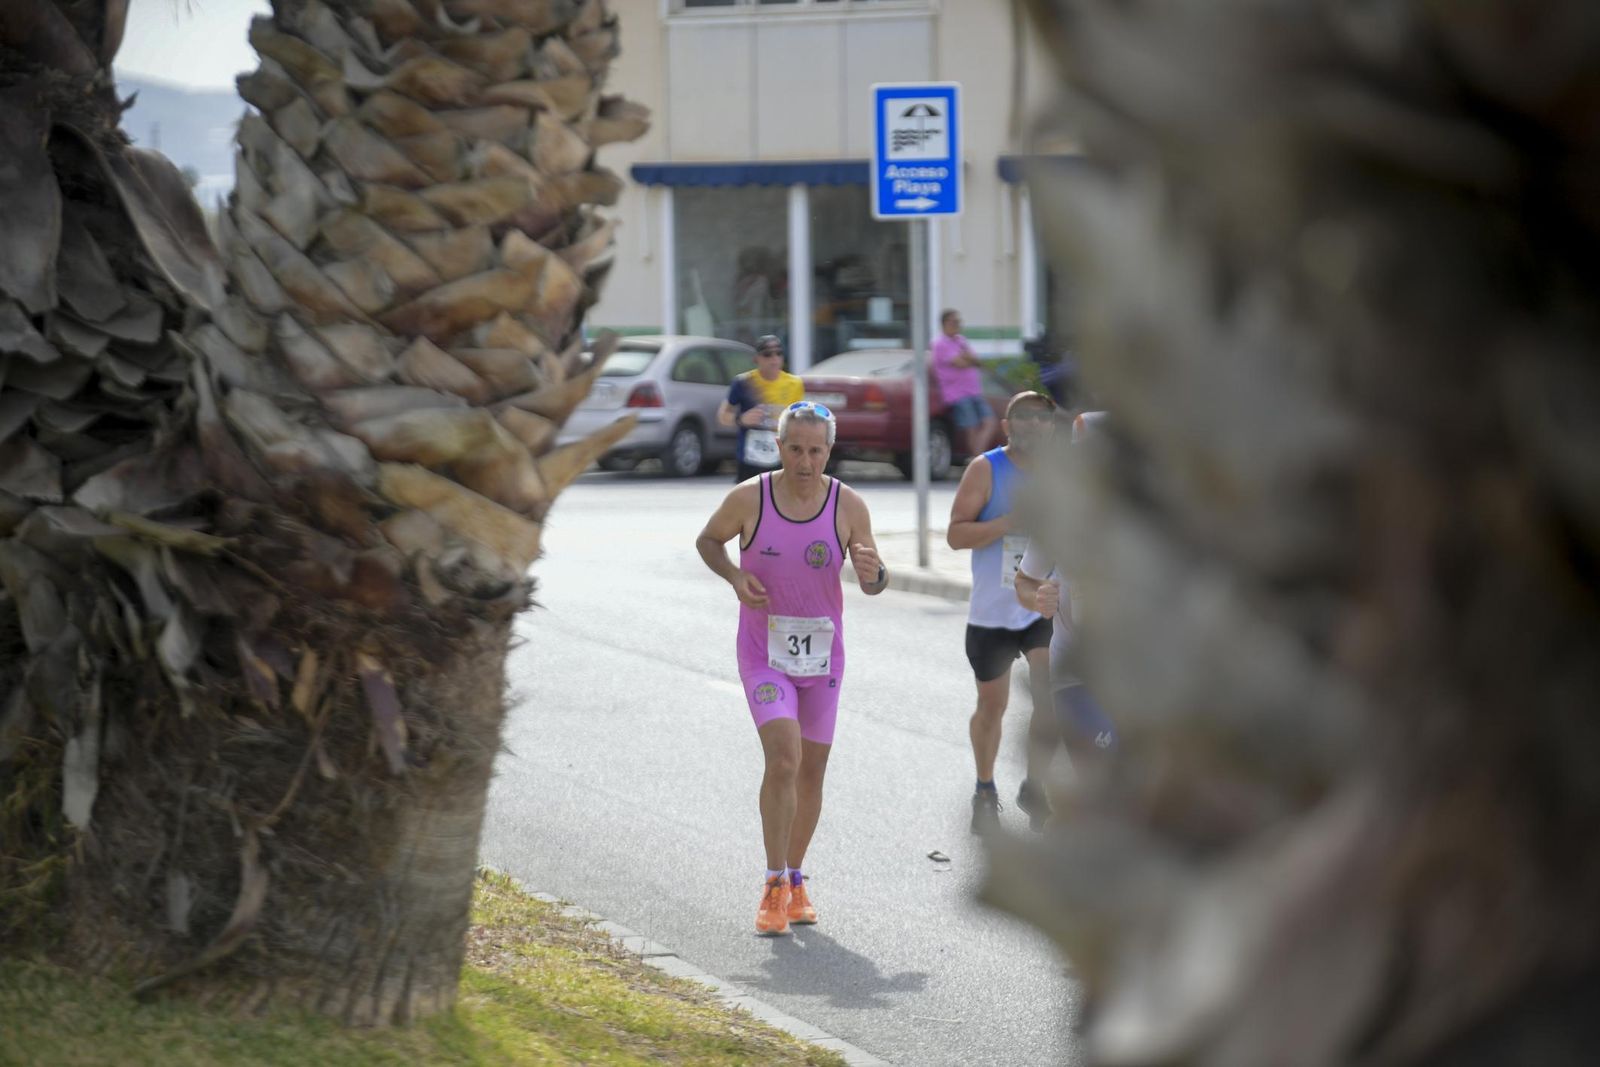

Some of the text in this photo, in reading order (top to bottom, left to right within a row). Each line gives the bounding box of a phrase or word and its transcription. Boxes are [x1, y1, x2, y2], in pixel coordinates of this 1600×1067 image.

[885, 164, 949, 179] Acceso
[893, 180, 942, 197] Playa
[787, 634, 812, 656] 31
